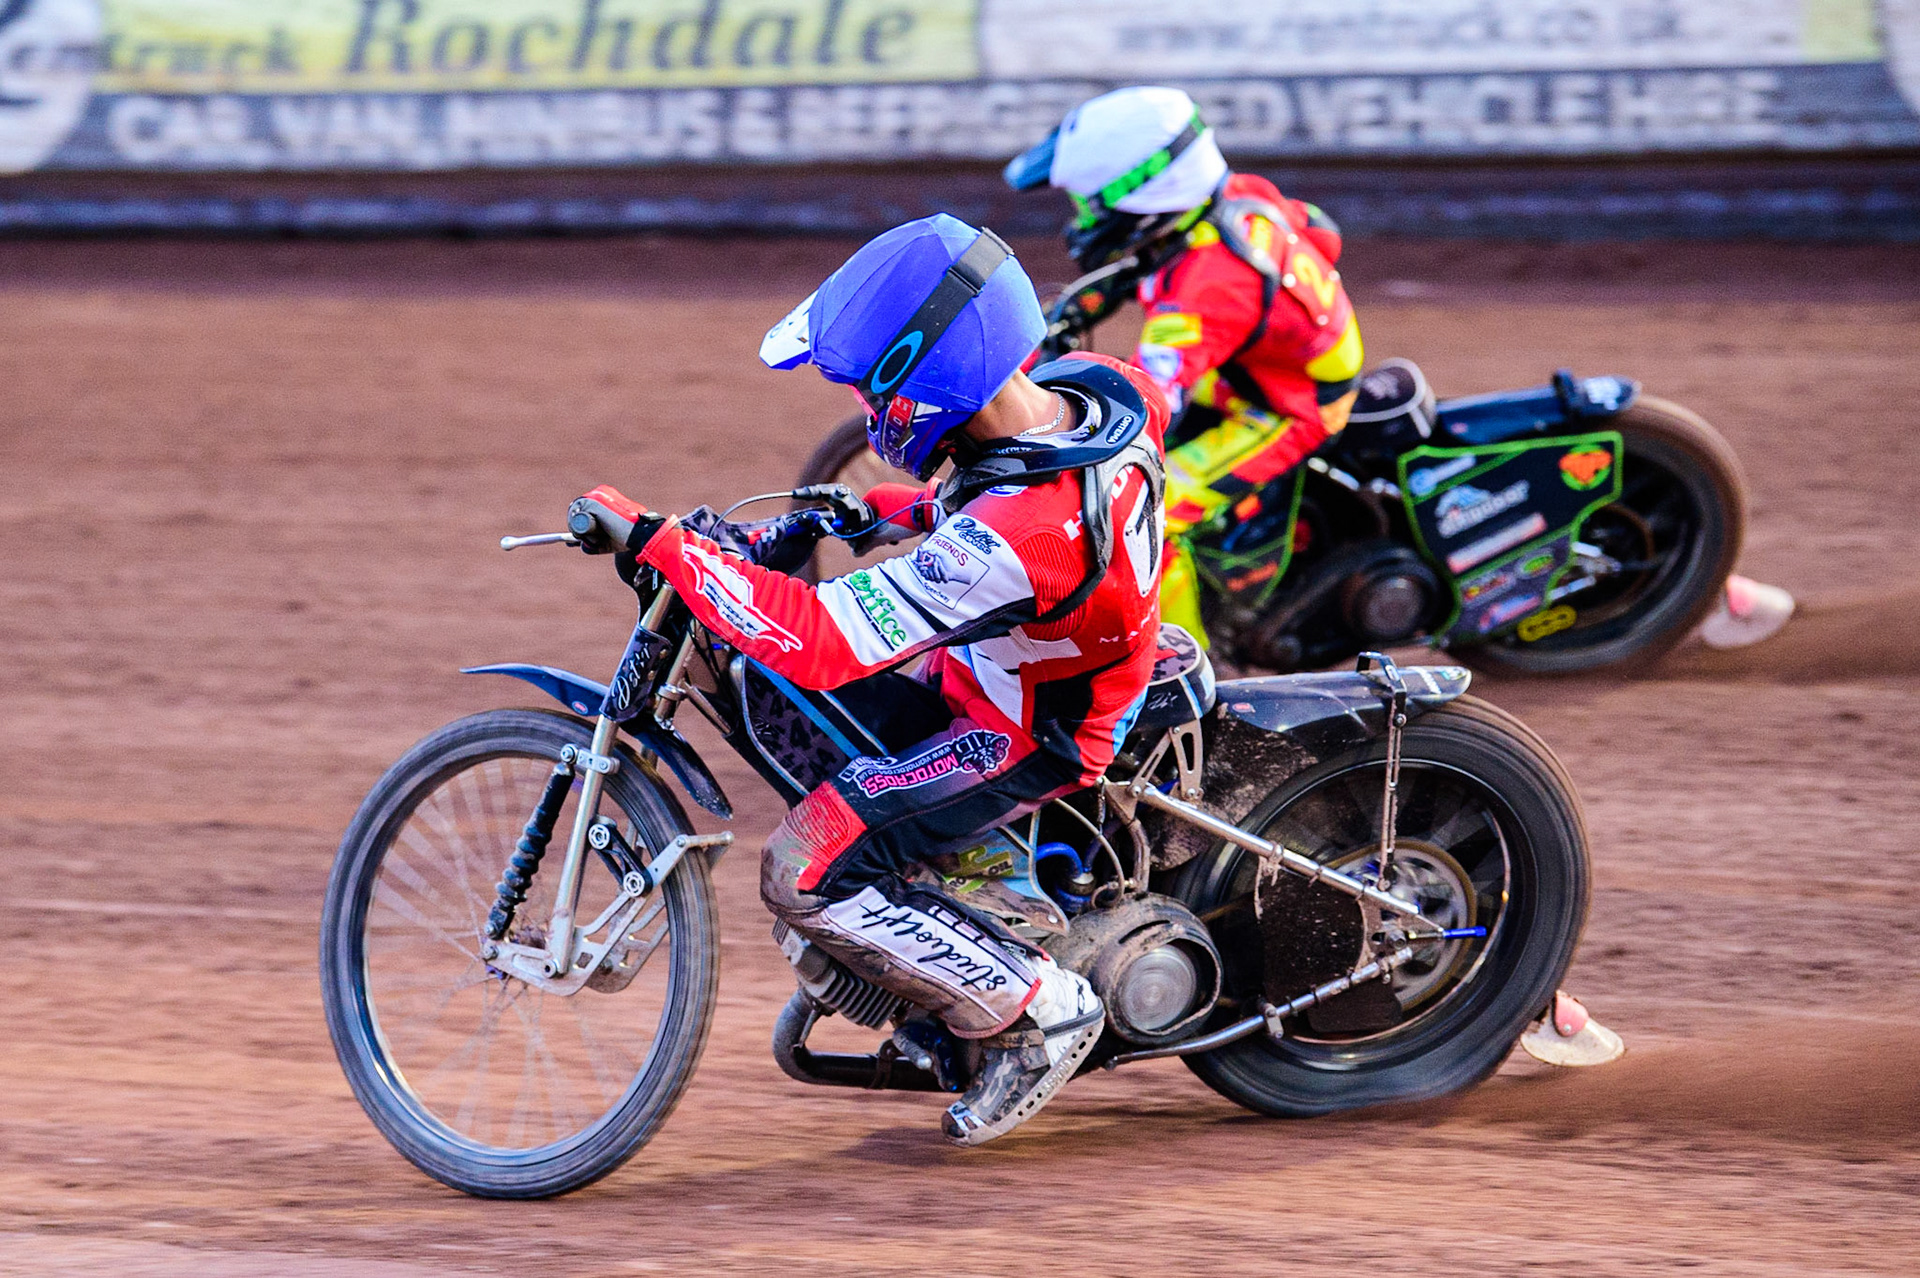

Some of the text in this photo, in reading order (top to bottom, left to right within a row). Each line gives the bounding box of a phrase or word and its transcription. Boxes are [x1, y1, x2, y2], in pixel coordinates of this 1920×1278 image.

[345, 0, 915, 75] Rochdale
[1107, 416, 1133, 443] ORTEMA
[929, 535, 969, 567] FRIENDS
[923, 582, 951, 604] Speedway
